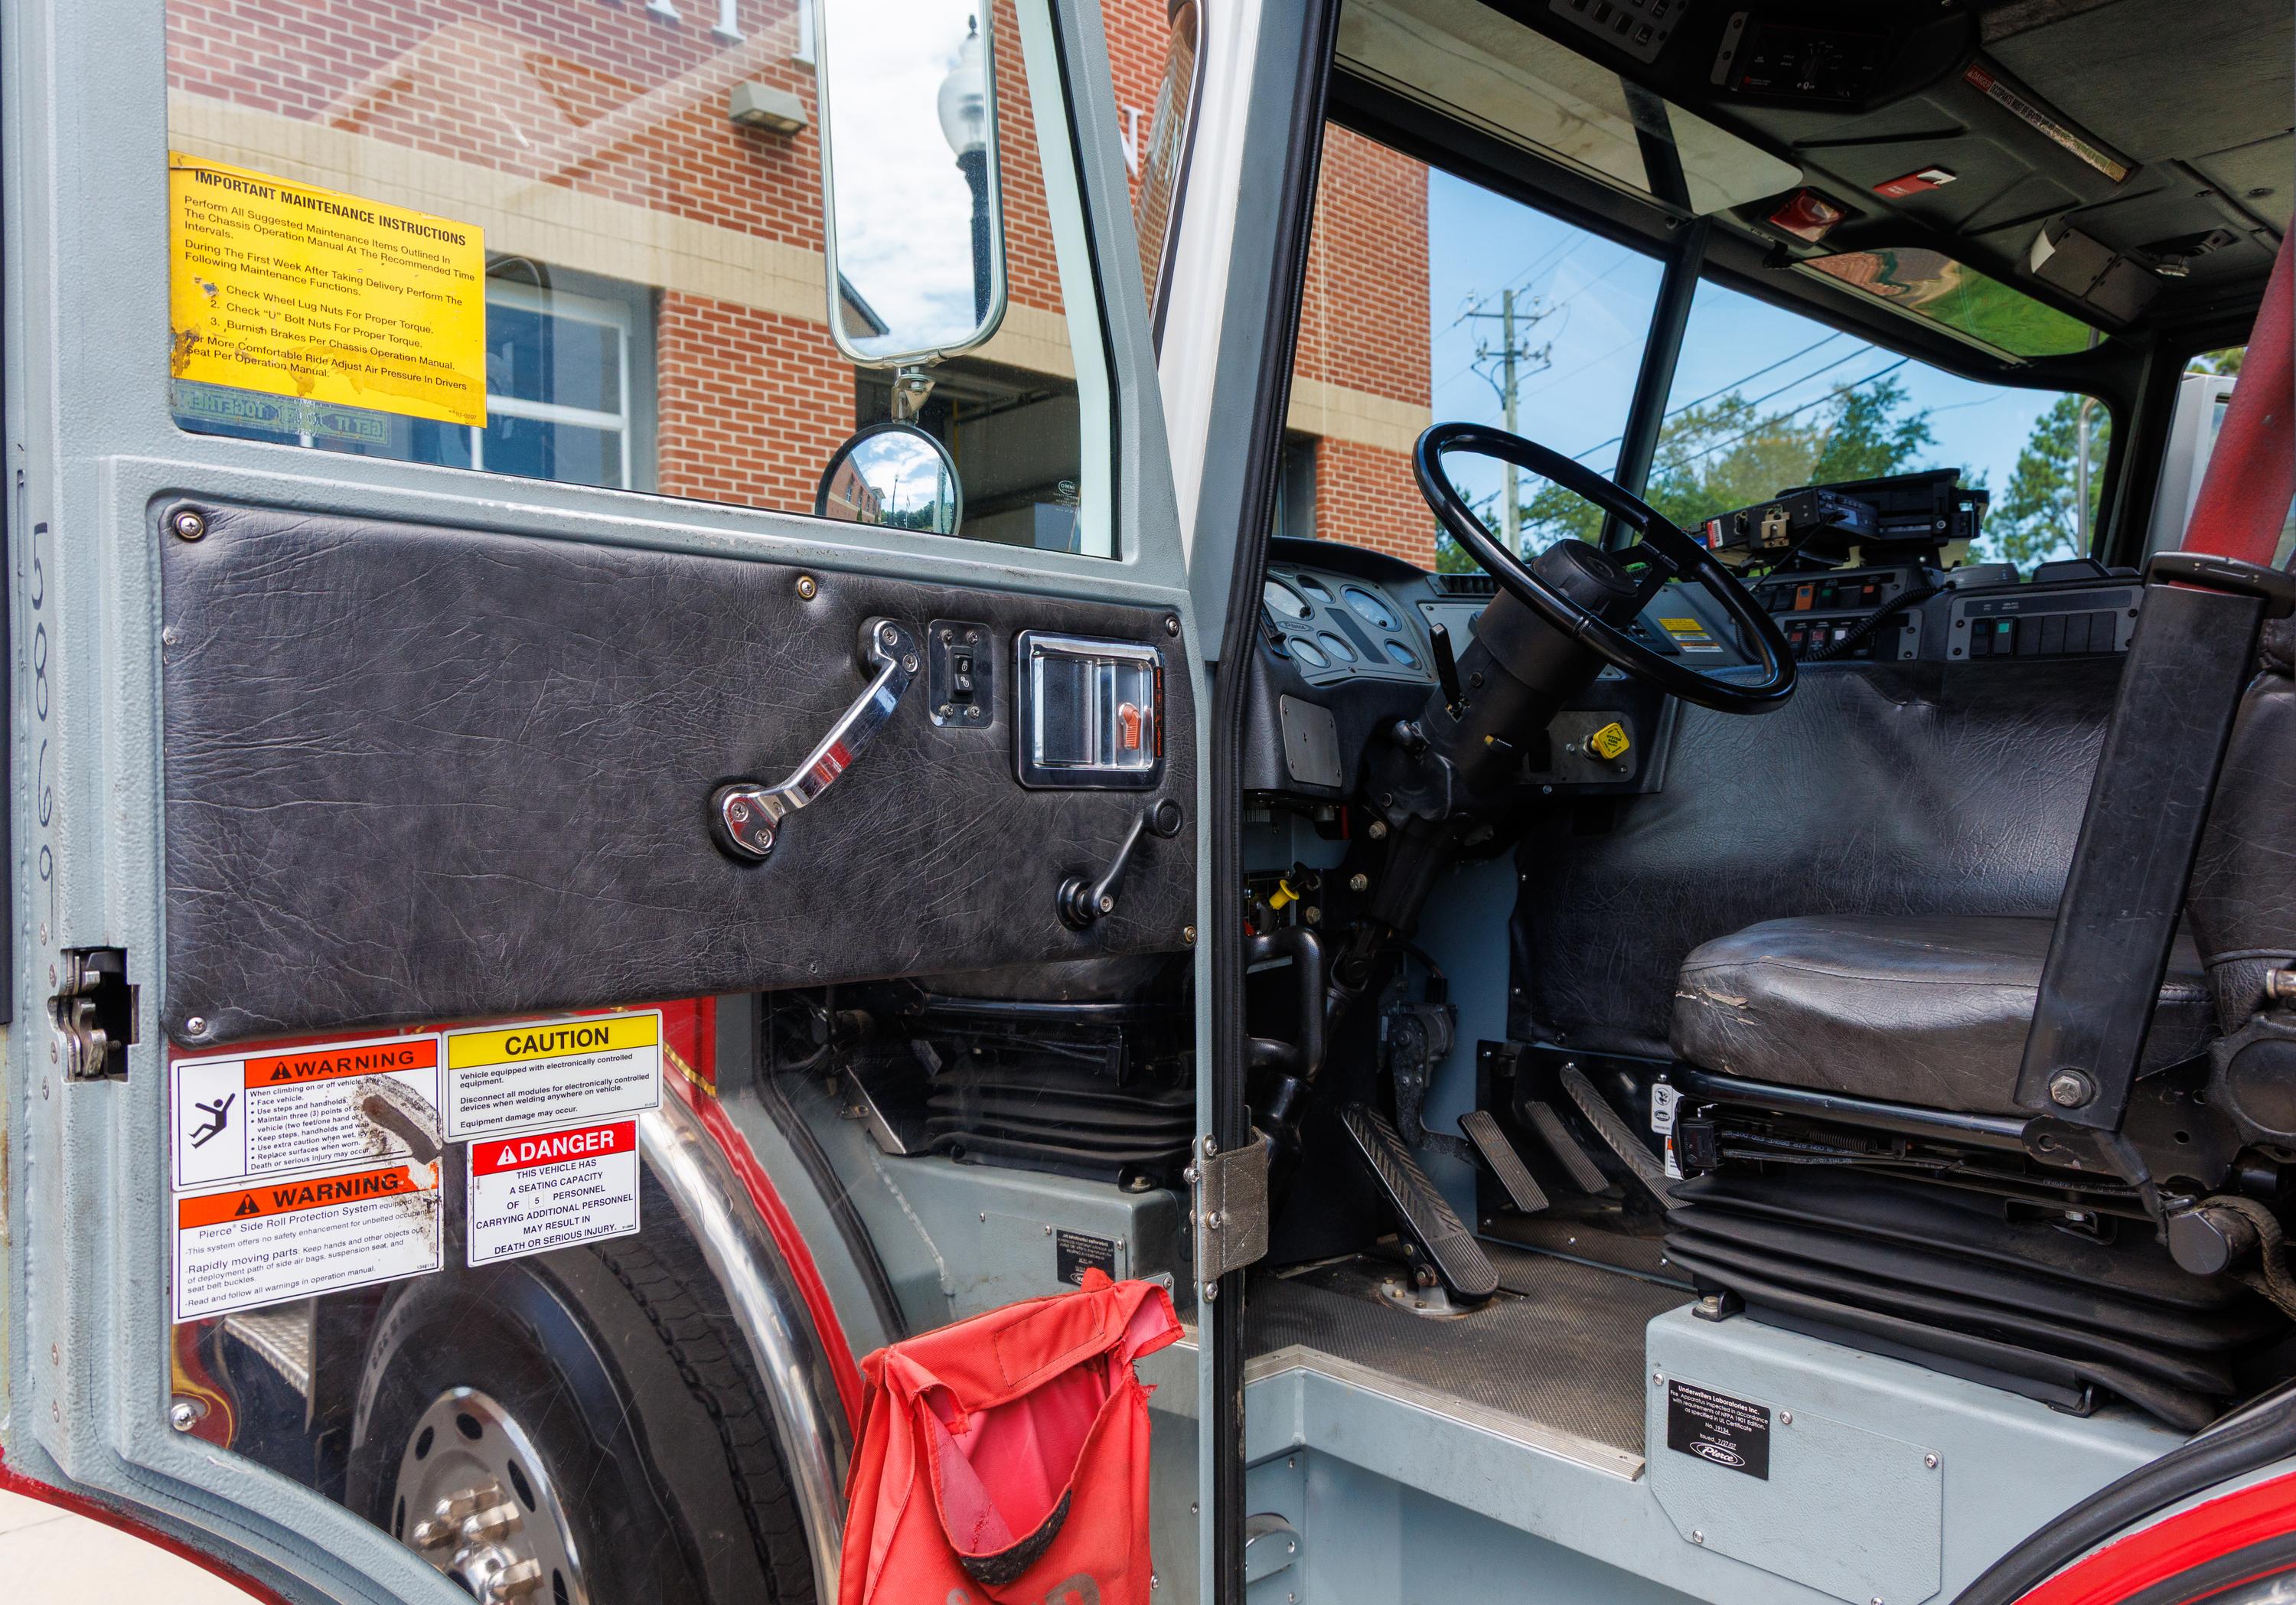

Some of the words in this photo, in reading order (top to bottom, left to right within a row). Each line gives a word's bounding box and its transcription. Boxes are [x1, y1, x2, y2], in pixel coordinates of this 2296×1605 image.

[195, 169, 276, 200] IMPORTANT
[281, 191, 374, 224] MAINTENANCE
[380, 215, 465, 246] INSTRUCTIONS
[184, 195, 227, 213] Perform
[231, 207, 244, 217] All
[248, 210, 303, 230] Suggested
[306, 223, 369, 246] Maintenance
[372, 239, 398, 253] Items
[401, 246, 439, 262] Outlined
[442, 256, 450, 264] In
[185, 220, 233, 239] Intervals.
[187, 208, 205, 220] The
[208, 214, 250, 230] Chassis
[253, 223, 305, 243] Operation
[308, 236, 344, 251] Manual
[347, 245, 357, 254] At
[360, 247, 378, 259] The
[381, 253, 451, 276] Recommended
[453, 269, 475, 281] Time
[185, 239, 220, 256] During
[224, 247, 243, 259] The
[247, 252, 270, 265] First
[273, 258, 302, 272] Week
[305, 265, 328, 277] After
[331, 270, 363, 286] Taking
[366, 278, 404, 295] Delivery
[406, 287, 443, 302] Perform
[445, 295, 462, 306] The
[185, 251, 236, 272] Following
[240, 263, 307, 284] Maintenance
[310, 278, 360, 295] Functions.
[210, 298, 220, 308] 2.
[227, 302, 260, 317] Check
[285, 314, 305, 325] Bolt
[308, 318, 331, 330] Nuts
[334, 323, 351, 334] For
[354, 327, 386, 340] Proper
[388, 334, 422, 347] Torque.
[227, 285, 259, 299] Check
[263, 292, 295, 306] Wheel
[298, 299, 317, 312] Lug
[320, 304, 343, 316] Nuts
[346, 309, 362, 319] For
[365, 313, 397, 326] Proper
[400, 320, 433, 334] Torque.
[210, 317, 220, 326] 3.
[227, 320, 267, 335] Burnish
[271, 328, 306, 342] Brakes
[309, 335, 326, 345] Per
[329, 339, 367, 354] Chassis
[370, 347, 416, 363] Operation
[419, 356, 455, 370] Manual.
[505, 1026, 608, 1055] CAUTION
[294, 1051, 414, 1077] WARNING
[460, 1072, 489, 1080] Vehicle
[491, 1066, 527, 1077] equipped
[546, 1059, 595, 1070] electronically
[597, 1053, 633, 1063] controlled
[460, 1075, 504, 1089] equipment.
[460, 1092, 504, 1104] Disconnect
[518, 1088, 550, 1097] modules
[565, 1078, 613, 1091] electronically
[615, 1073, 650, 1084] controlled
[276, 1094, 304, 1103] vehicle.
[310, 1096, 348, 1108] handholds.
[460, 1103, 491, 1112] devices
[516, 1096, 546, 1104] welding
[547, 1091, 582, 1101] anywhere
[595, 1085, 623, 1094] vehicle.
[461, 1117, 503, 1128] Equipment
[505, 1113, 536, 1122] damage
[520, 1130, 614, 1162] DANGER
[516, 1169, 536, 1179] THIS
[539, 1162, 576, 1176] VEHICLE
[579, 1159, 597, 1169] HAS
[518, 1179, 557, 1193] SEATING
[559, 1171, 603, 1186] CAPACITY
[273, 1173, 399, 1208] WARNING
[507, 1200, 520, 1210] OF
[553, 1185, 605, 1201] PERSONNEL
[240, 1222, 263, 1232] Side
[267, 1217, 285, 1228] Roll
[289, 1210, 339, 1224] Protection
[342, 1204, 377, 1216] System
[380, 1196, 413, 1209] equipped
[476, 1214, 523, 1230] CARRYING
[527, 1204, 580, 1220] ADDITIONAL
[582, 1194, 634, 1210] PERSONNEL
[523, 1224, 543, 1235] MAY
[546, 1217, 580, 1231] RESULT
[582, 1215, 590, 1223] IN
[494, 1241, 525, 1254] DEATH
[528, 1238, 541, 1248] OR
[543, 1230, 582, 1245] SERIOUS
[585, 1224, 617, 1236] INJURY.
[188, 1285, 204, 1293] seat
[224, 1277, 256, 1287] buckles.
[1678, 1385, 1712, 1401] Underwriters
[1713, 1395, 1748, 1411] Laboratories
[1749, 1406, 1760, 1415] Inc.
[1701, 1446, 1734, 1463] Pierce
